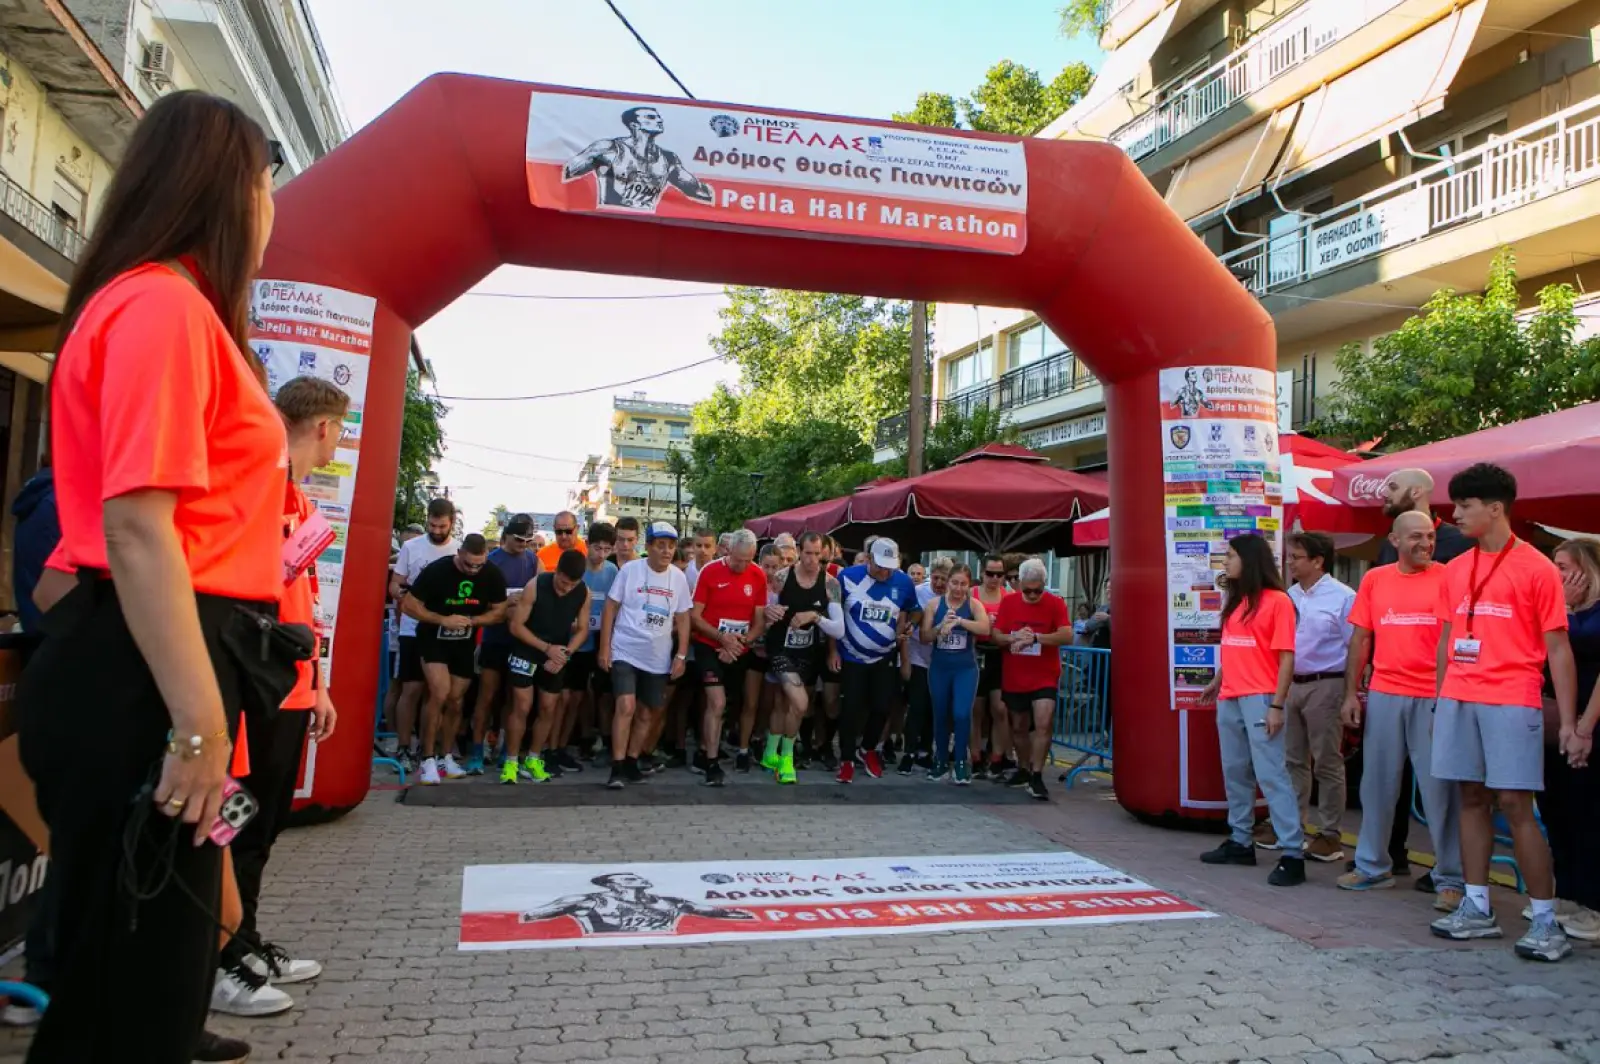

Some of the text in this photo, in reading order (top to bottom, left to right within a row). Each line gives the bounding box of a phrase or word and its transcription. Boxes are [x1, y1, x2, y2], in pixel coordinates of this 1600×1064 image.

[744, 117, 800, 129] ΔΗΜΟΣ
[743, 125, 867, 153] ΠΕΛΛΑΣ
[693, 146, 786, 173] Δρόμος
[891, 166, 1022, 197] Γιαννιτσών
[721, 188, 1018, 238] Pella Half Marathon
[271, 288, 323, 306] ΠΕΛΛΑΣ
[266, 322, 369, 348] Pella Half Marathon
[705, 886, 834, 900] Δρόμος
[764, 896, 1181, 922] Pella Half Marathon
